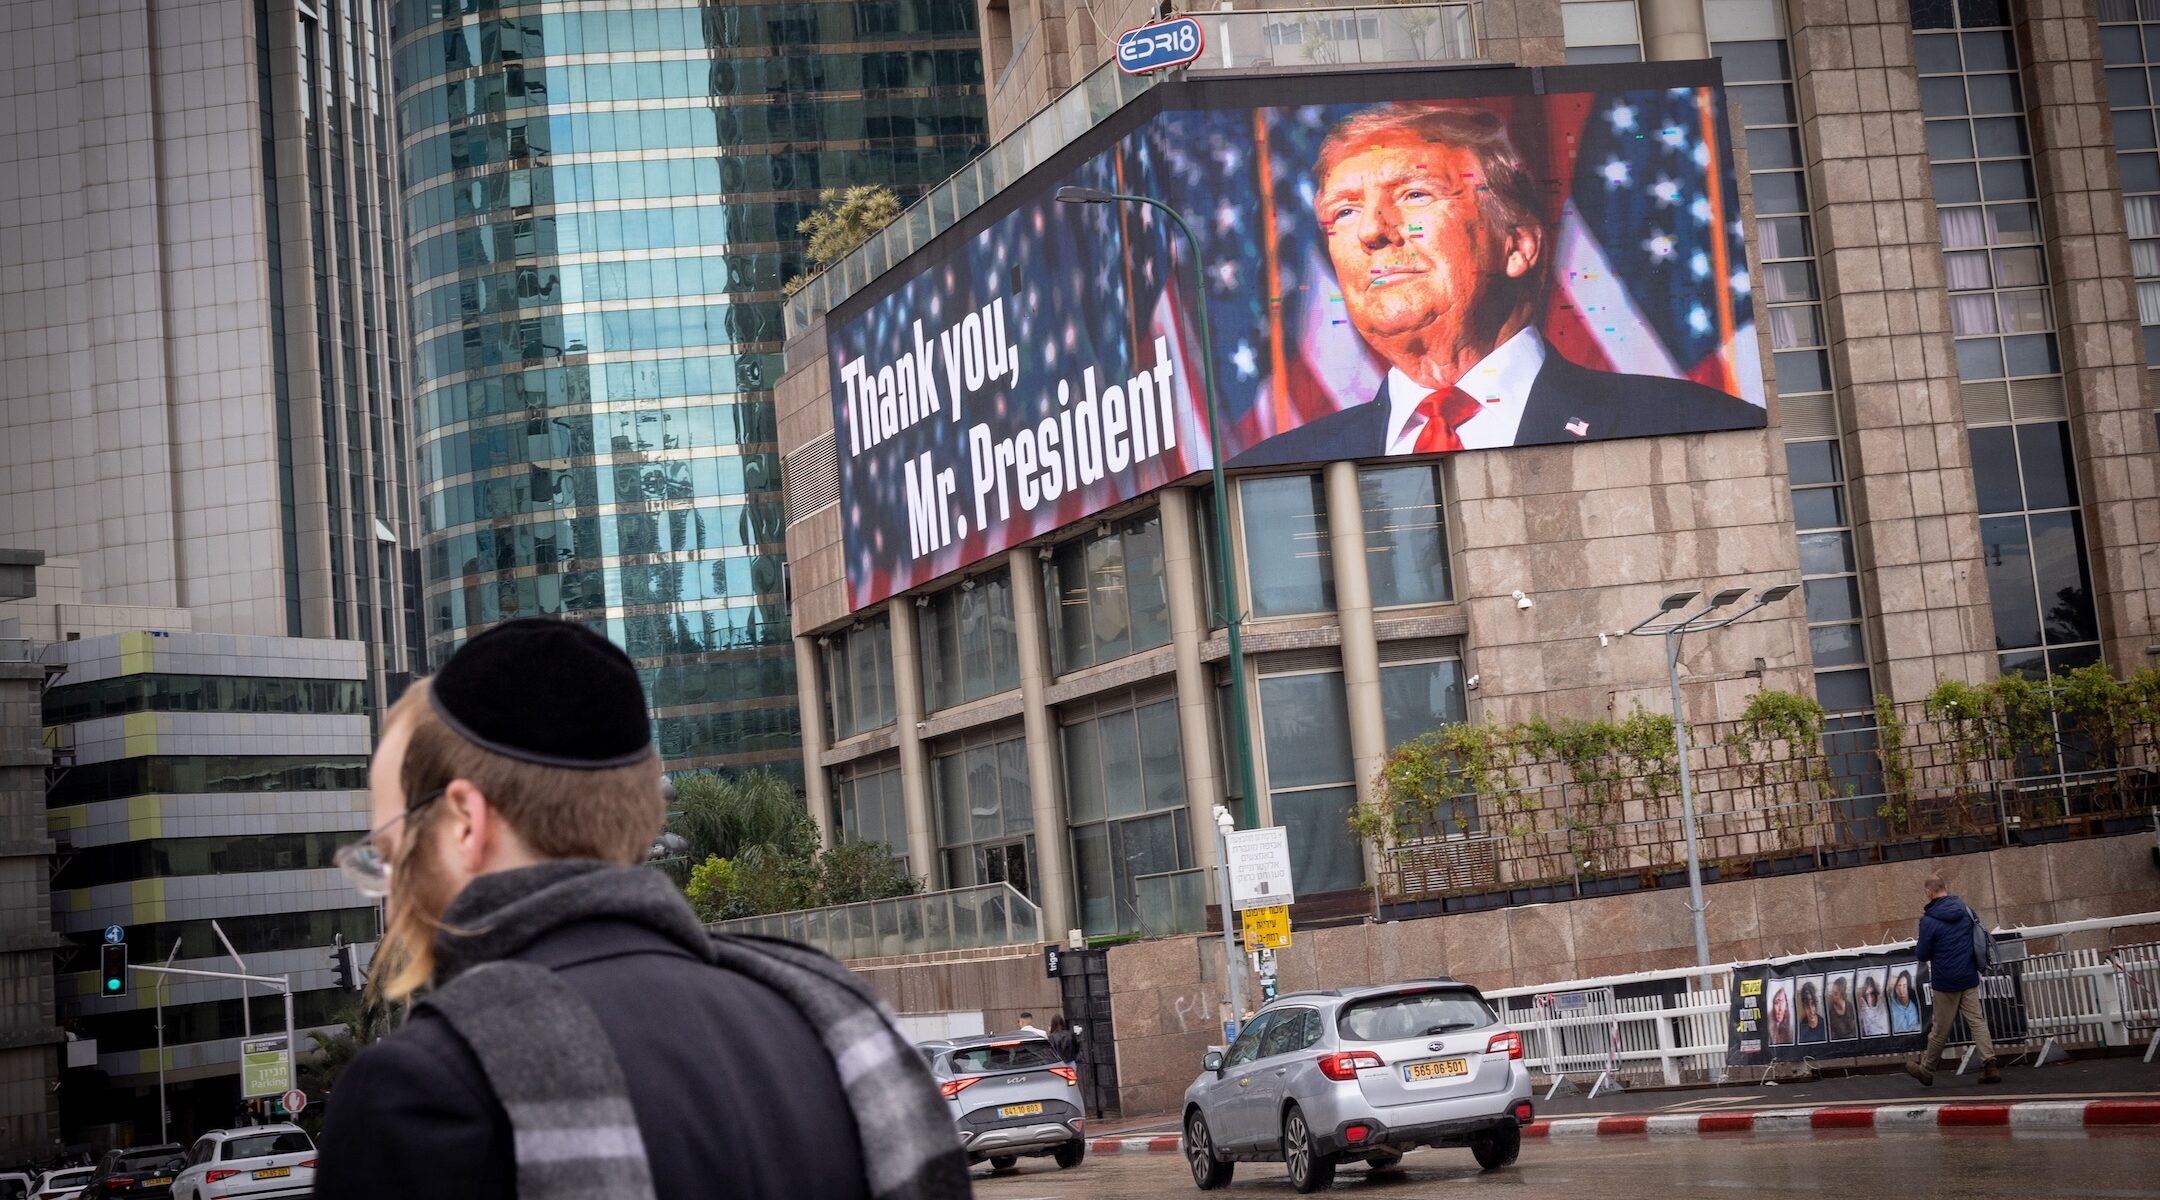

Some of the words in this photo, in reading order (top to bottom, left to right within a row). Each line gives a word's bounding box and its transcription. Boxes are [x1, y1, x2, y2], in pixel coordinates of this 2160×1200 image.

[841, 319, 941, 457] Thank
[940, 296, 1019, 423] you,
[904, 450, 968, 560] Mr.
[969, 335, 1177, 532] President
[1048, 952, 1059, 972] trigo
[251, 1078, 288, 1089] Parking
[259, 1067, 287, 1081] חניון
